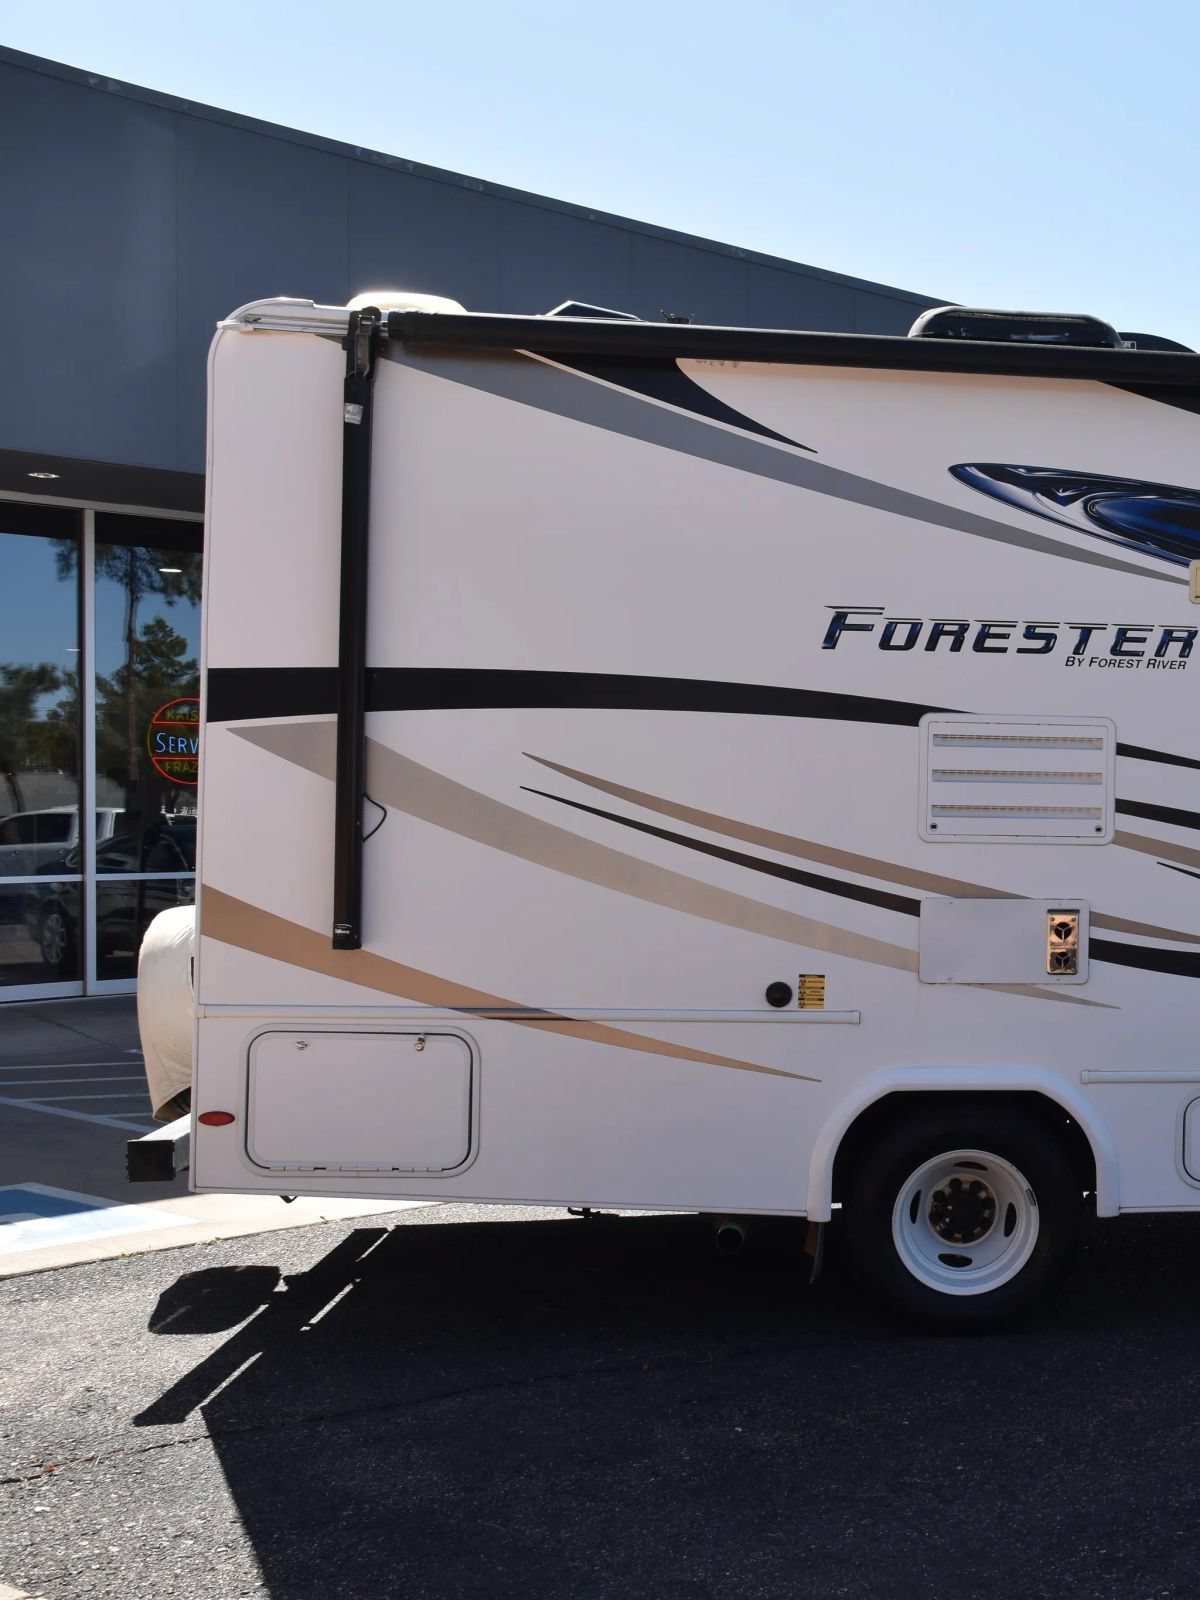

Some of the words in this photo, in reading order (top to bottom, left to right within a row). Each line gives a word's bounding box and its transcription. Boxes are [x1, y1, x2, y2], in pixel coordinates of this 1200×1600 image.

[821, 605, 1199, 659] FORESTER
[1088, 656, 1143, 669] FOREST
[1146, 658, 1188, 670] RIVER
